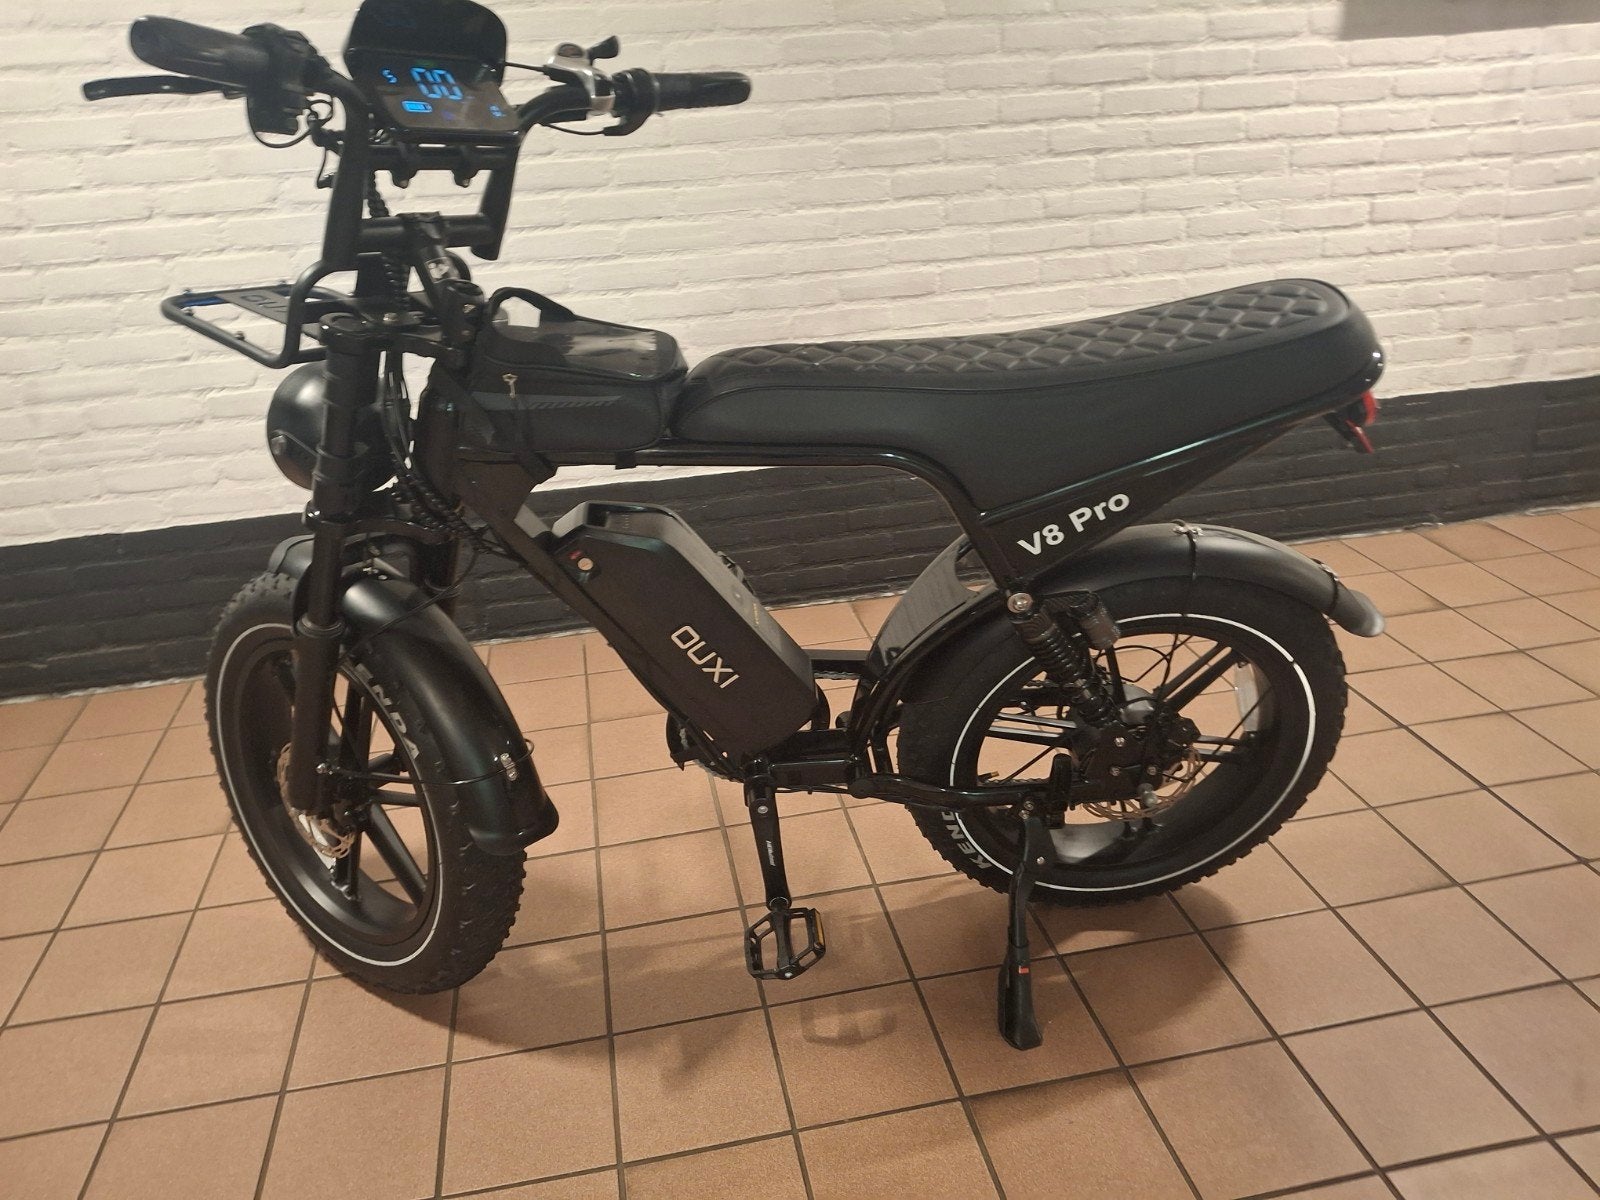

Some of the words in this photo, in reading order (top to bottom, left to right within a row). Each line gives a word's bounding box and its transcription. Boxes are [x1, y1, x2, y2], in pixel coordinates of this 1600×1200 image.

[1017, 524, 1065, 555] V8
[1068, 493, 1130, 532] Pro
[671, 625, 740, 689] OUXI
[941, 811, 992, 869] KEND
